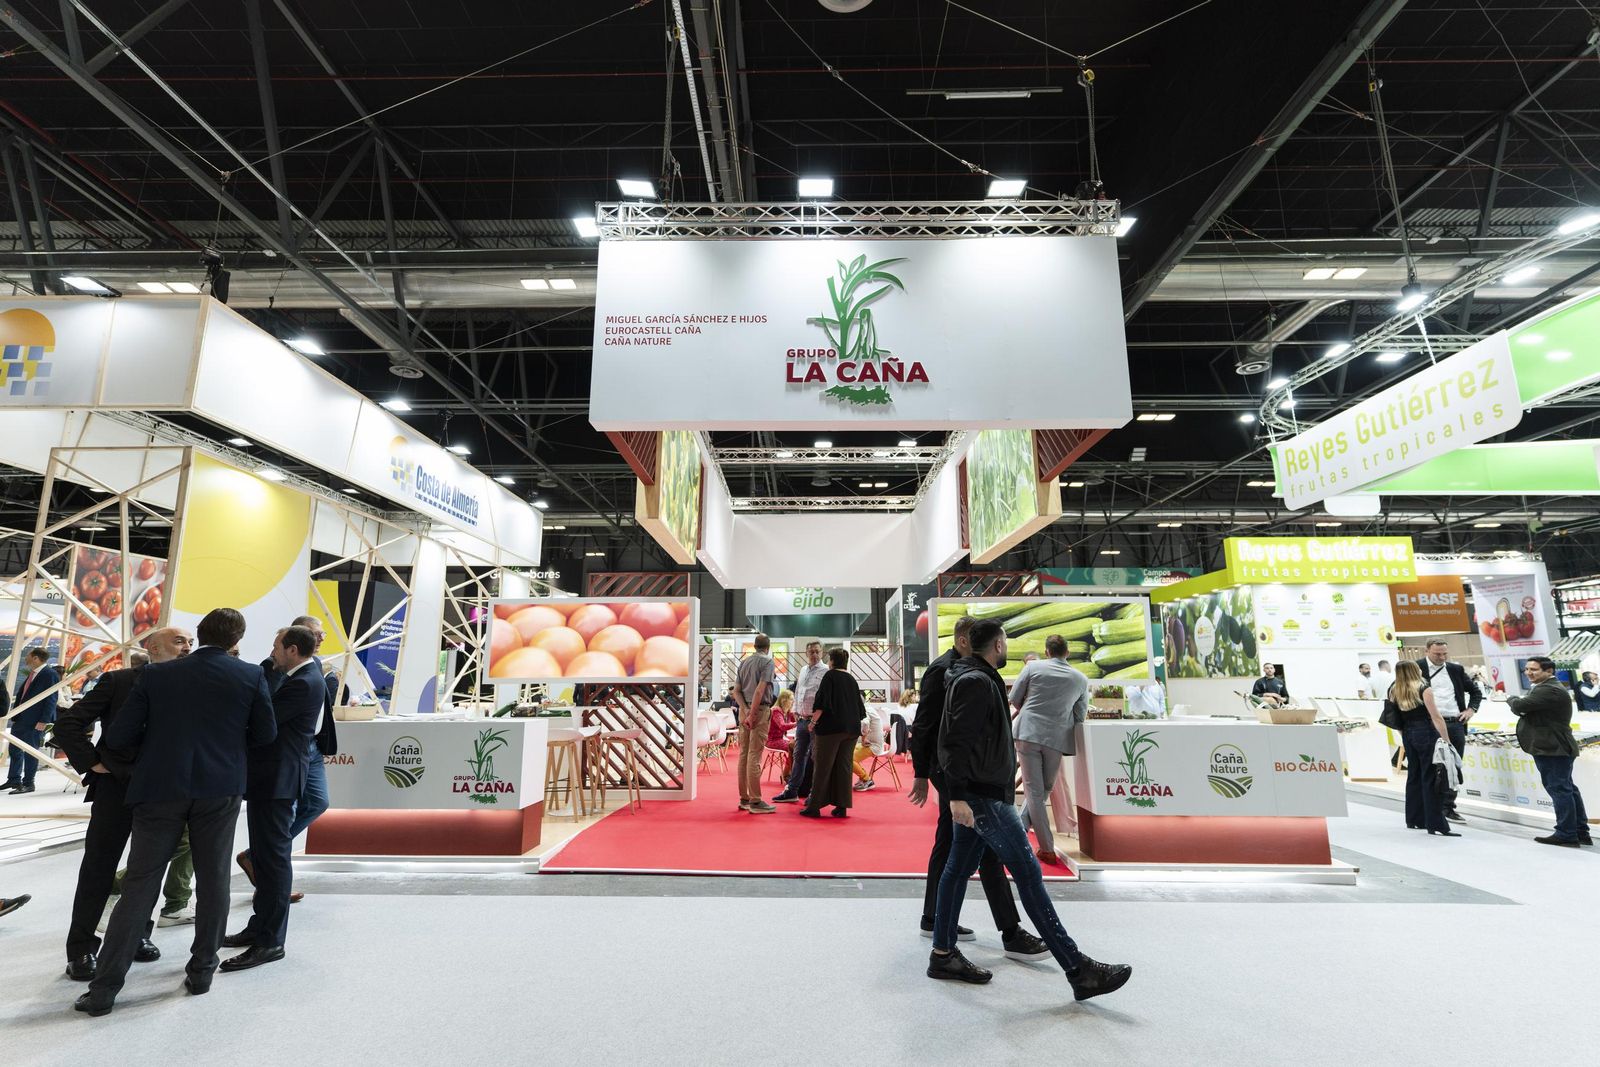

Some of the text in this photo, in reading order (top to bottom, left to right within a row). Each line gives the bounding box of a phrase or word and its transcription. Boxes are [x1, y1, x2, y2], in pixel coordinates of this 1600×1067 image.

[605, 313, 768, 324] MIGUEL GARCÍA SÁNCHEZ E HIJOS
[605, 325, 702, 335] EUROCASTELL CAÑA
[604, 336, 672, 346] CAÑA NATURE
[786, 348, 837, 358] GRUPO
[786, 357, 930, 382] LA CAÑA
[1284, 358, 1499, 477] Reyes Gutiérrez
[1290, 403, 1505, 498] frutas tropicales
[416, 465, 479, 520] Costa de Almería
[1237, 536, 1409, 566] Reyes Gutiérrez
[1143, 568, 1171, 577] Campos
[1242, 565, 1411, 579] frutas tropicales
[793, 592, 834, 610] ejido
[1418, 593, 1459, 605] BASF
[393, 744, 420, 755] Caña
[388, 755, 423, 764] Nature
[1214, 752, 1244, 764] Caña
[1479, 751, 1535, 775] Gutiérr
[1210, 764, 1248, 774] Nature
[1274, 759, 1338, 772] BIO CAÑA
[452, 780, 515, 793] LA CAÑA
[1106, 783, 1174, 797] LA CAÑA
